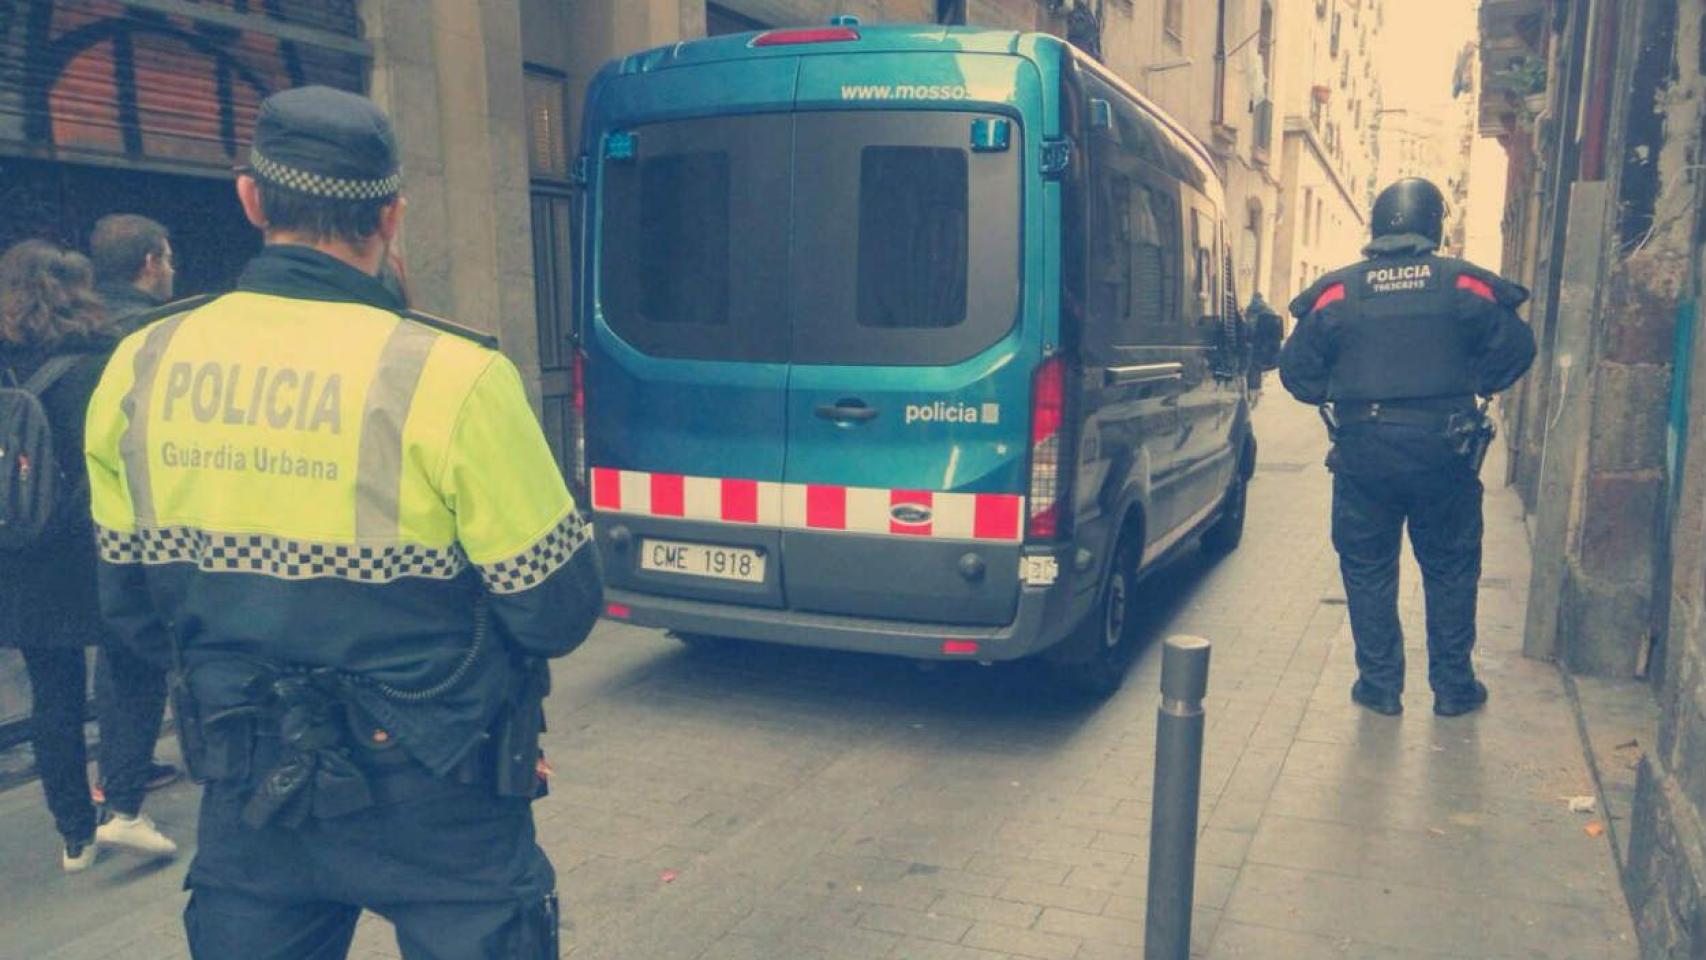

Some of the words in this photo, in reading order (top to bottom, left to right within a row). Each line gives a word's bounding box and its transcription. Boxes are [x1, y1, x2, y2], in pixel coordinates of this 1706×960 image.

[1366, 264, 1431, 284] POLICIA
[162, 361, 343, 434] POLICIA
[906, 401, 977, 424] policia
[254, 447, 339, 480] Urbana
[653, 544, 688, 569] CME
[704, 549, 751, 577] 1918
